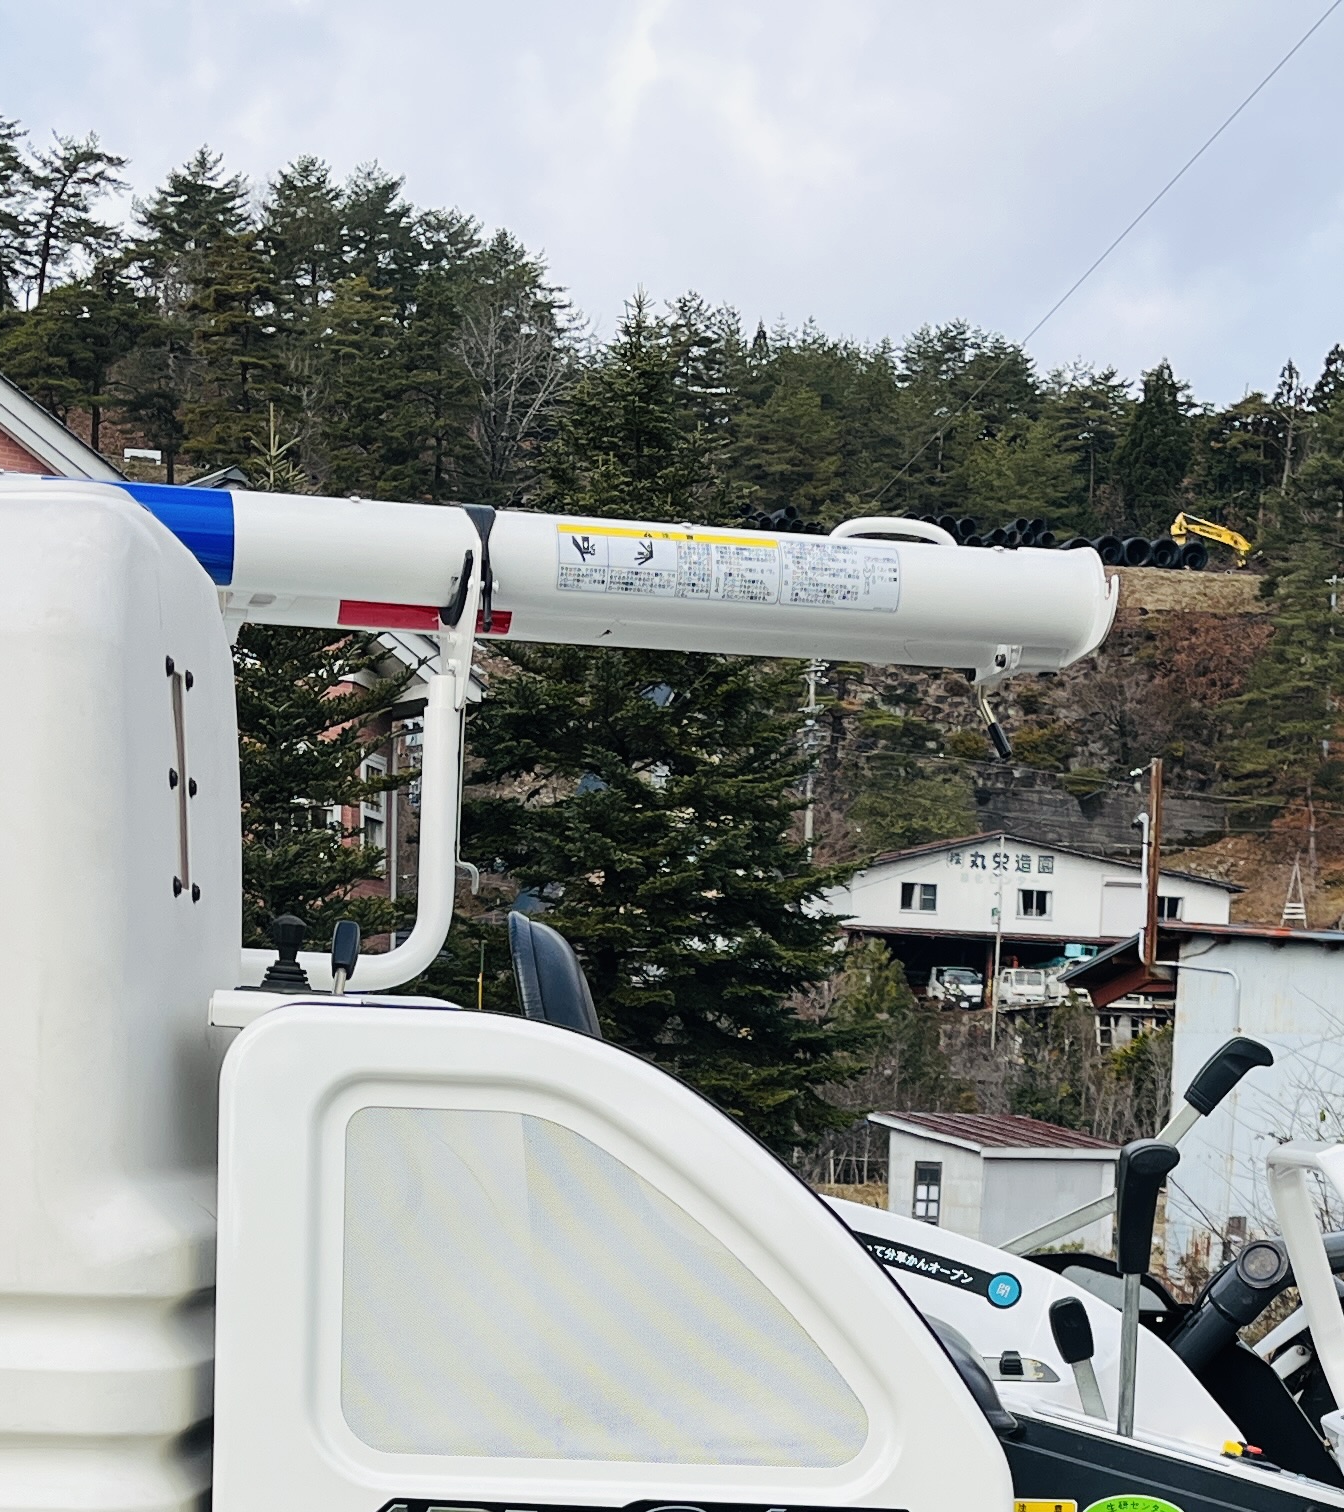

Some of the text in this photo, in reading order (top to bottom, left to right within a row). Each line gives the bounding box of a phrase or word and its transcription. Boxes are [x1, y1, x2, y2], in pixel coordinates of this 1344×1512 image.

[867, 1245, 973, 1284] て分草かんオープン
